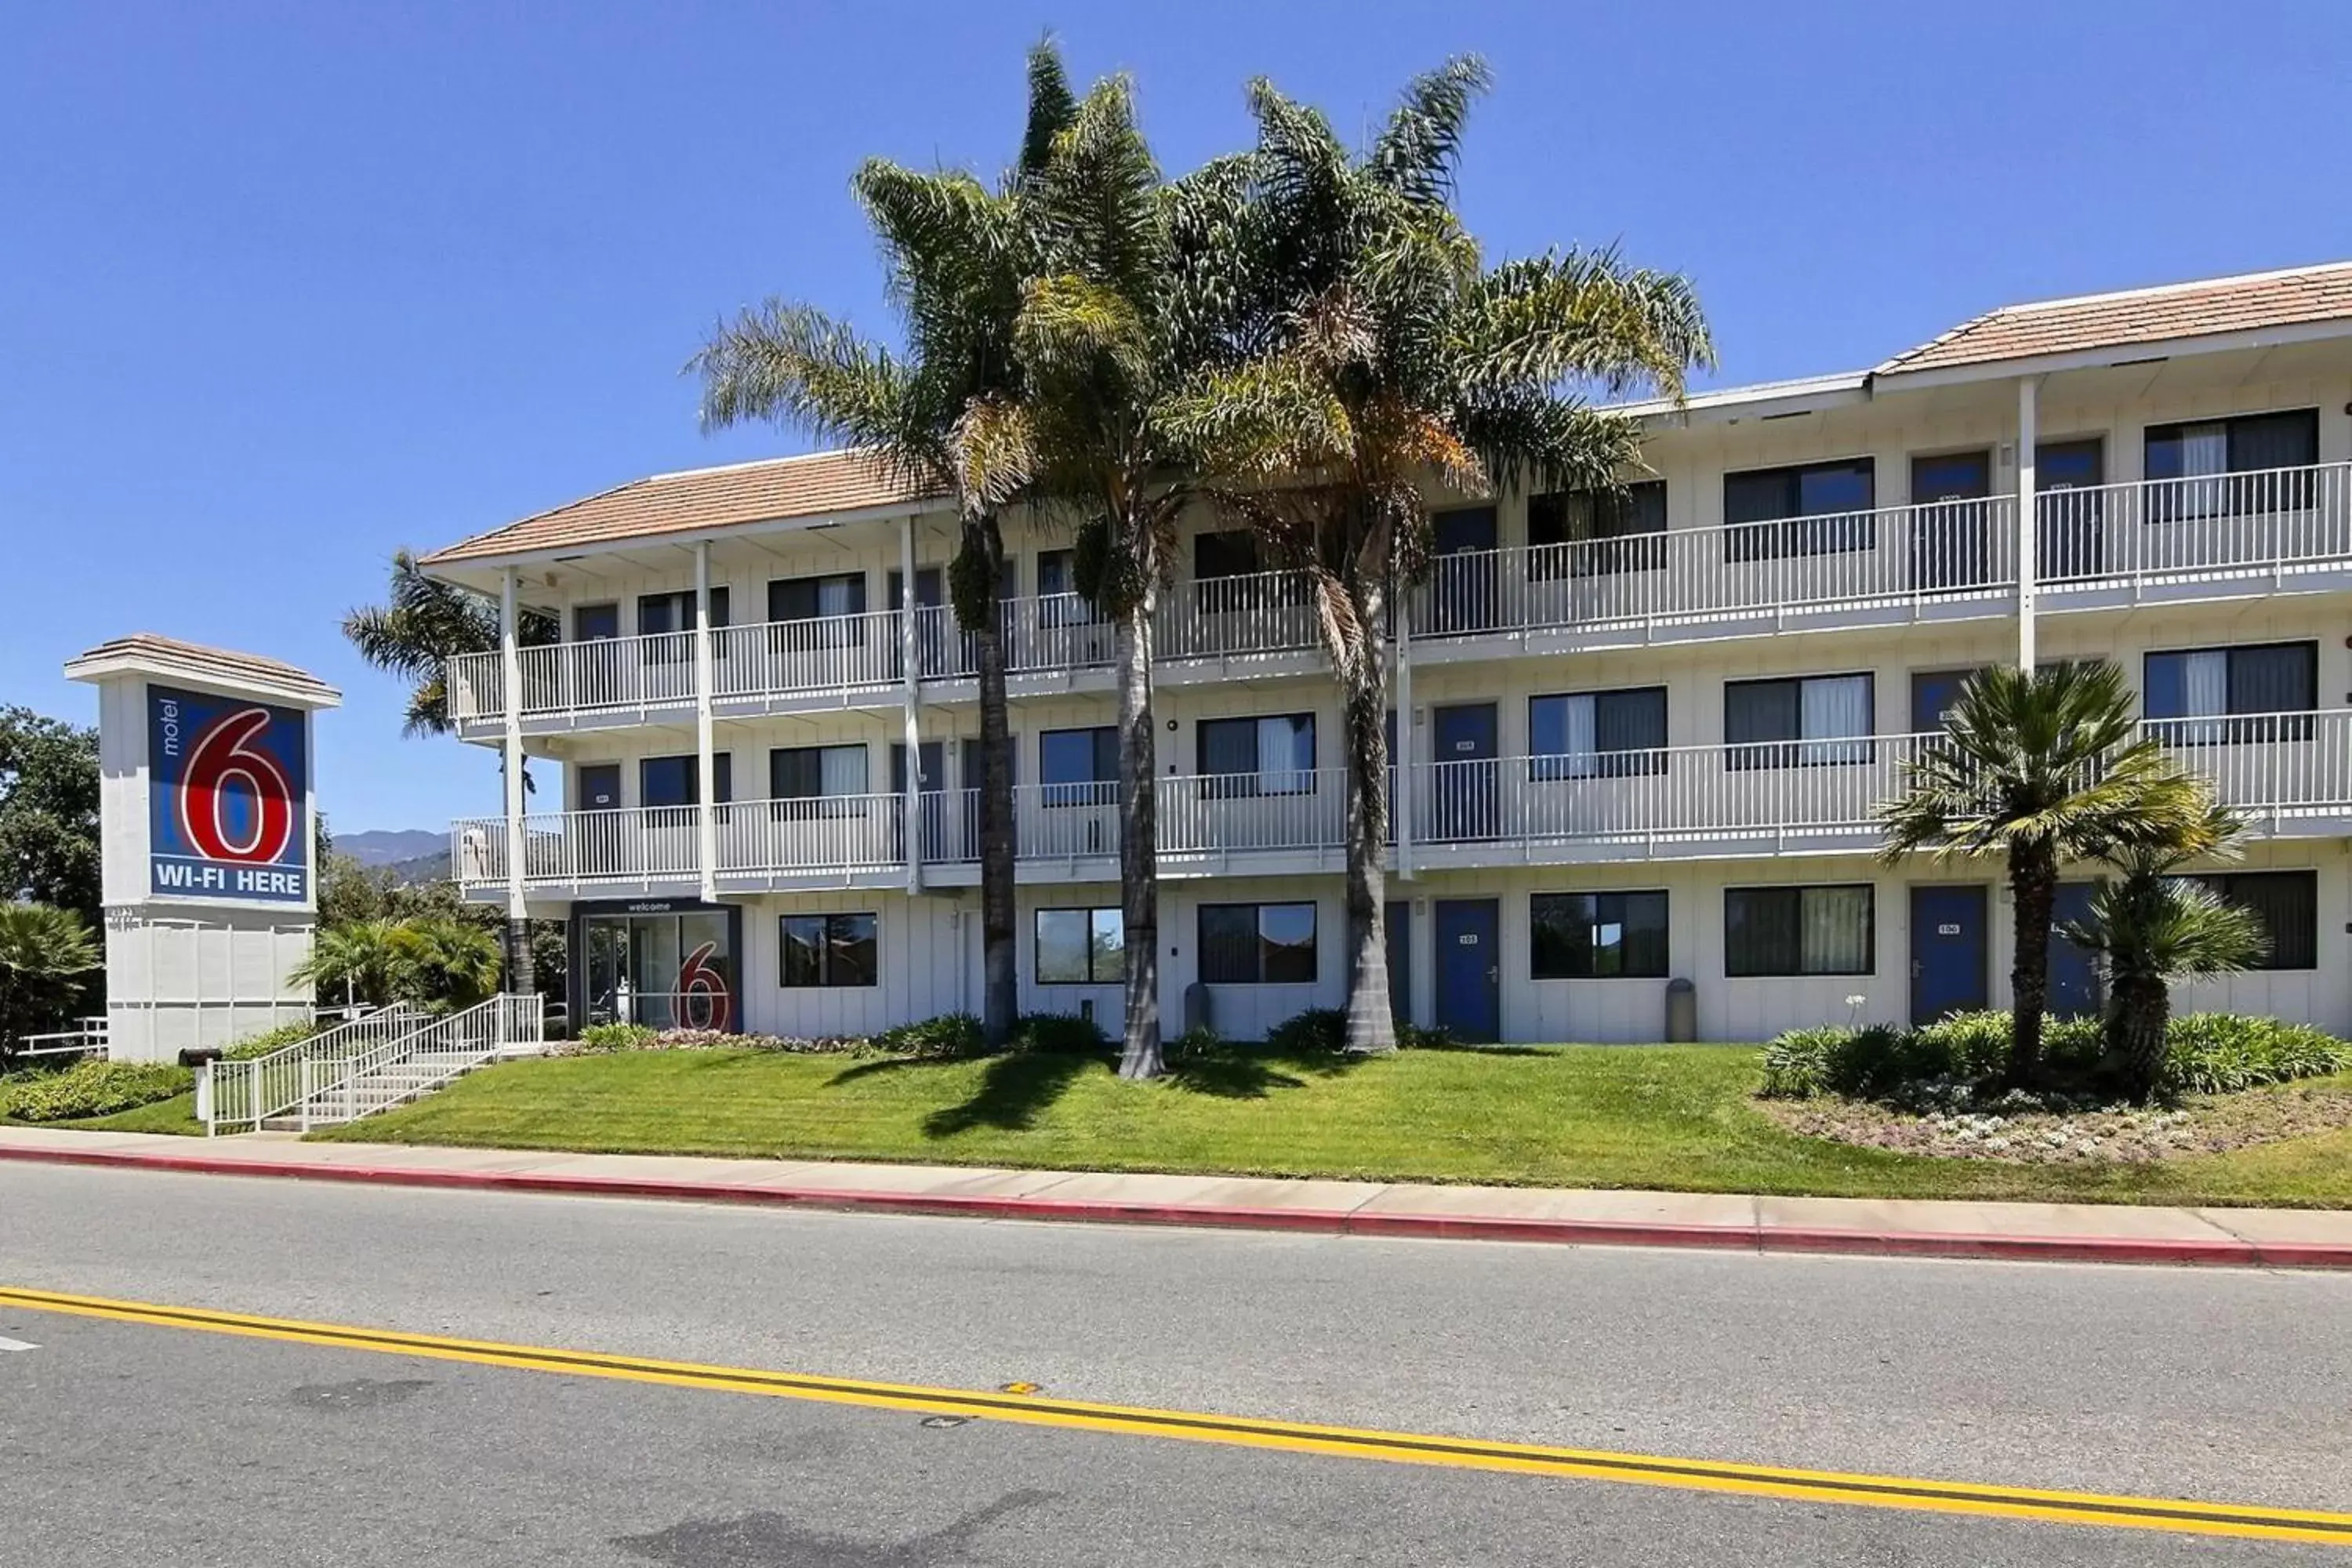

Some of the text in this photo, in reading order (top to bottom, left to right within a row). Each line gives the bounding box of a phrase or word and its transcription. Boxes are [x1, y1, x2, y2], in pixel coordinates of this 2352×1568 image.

[159, 699, 178, 757] motel
[181, 709, 292, 864] 6
[156, 863, 300, 895] WI-FI HERE
[629, 902, 672, 912] welcome
[670, 941, 728, 1030] 6
